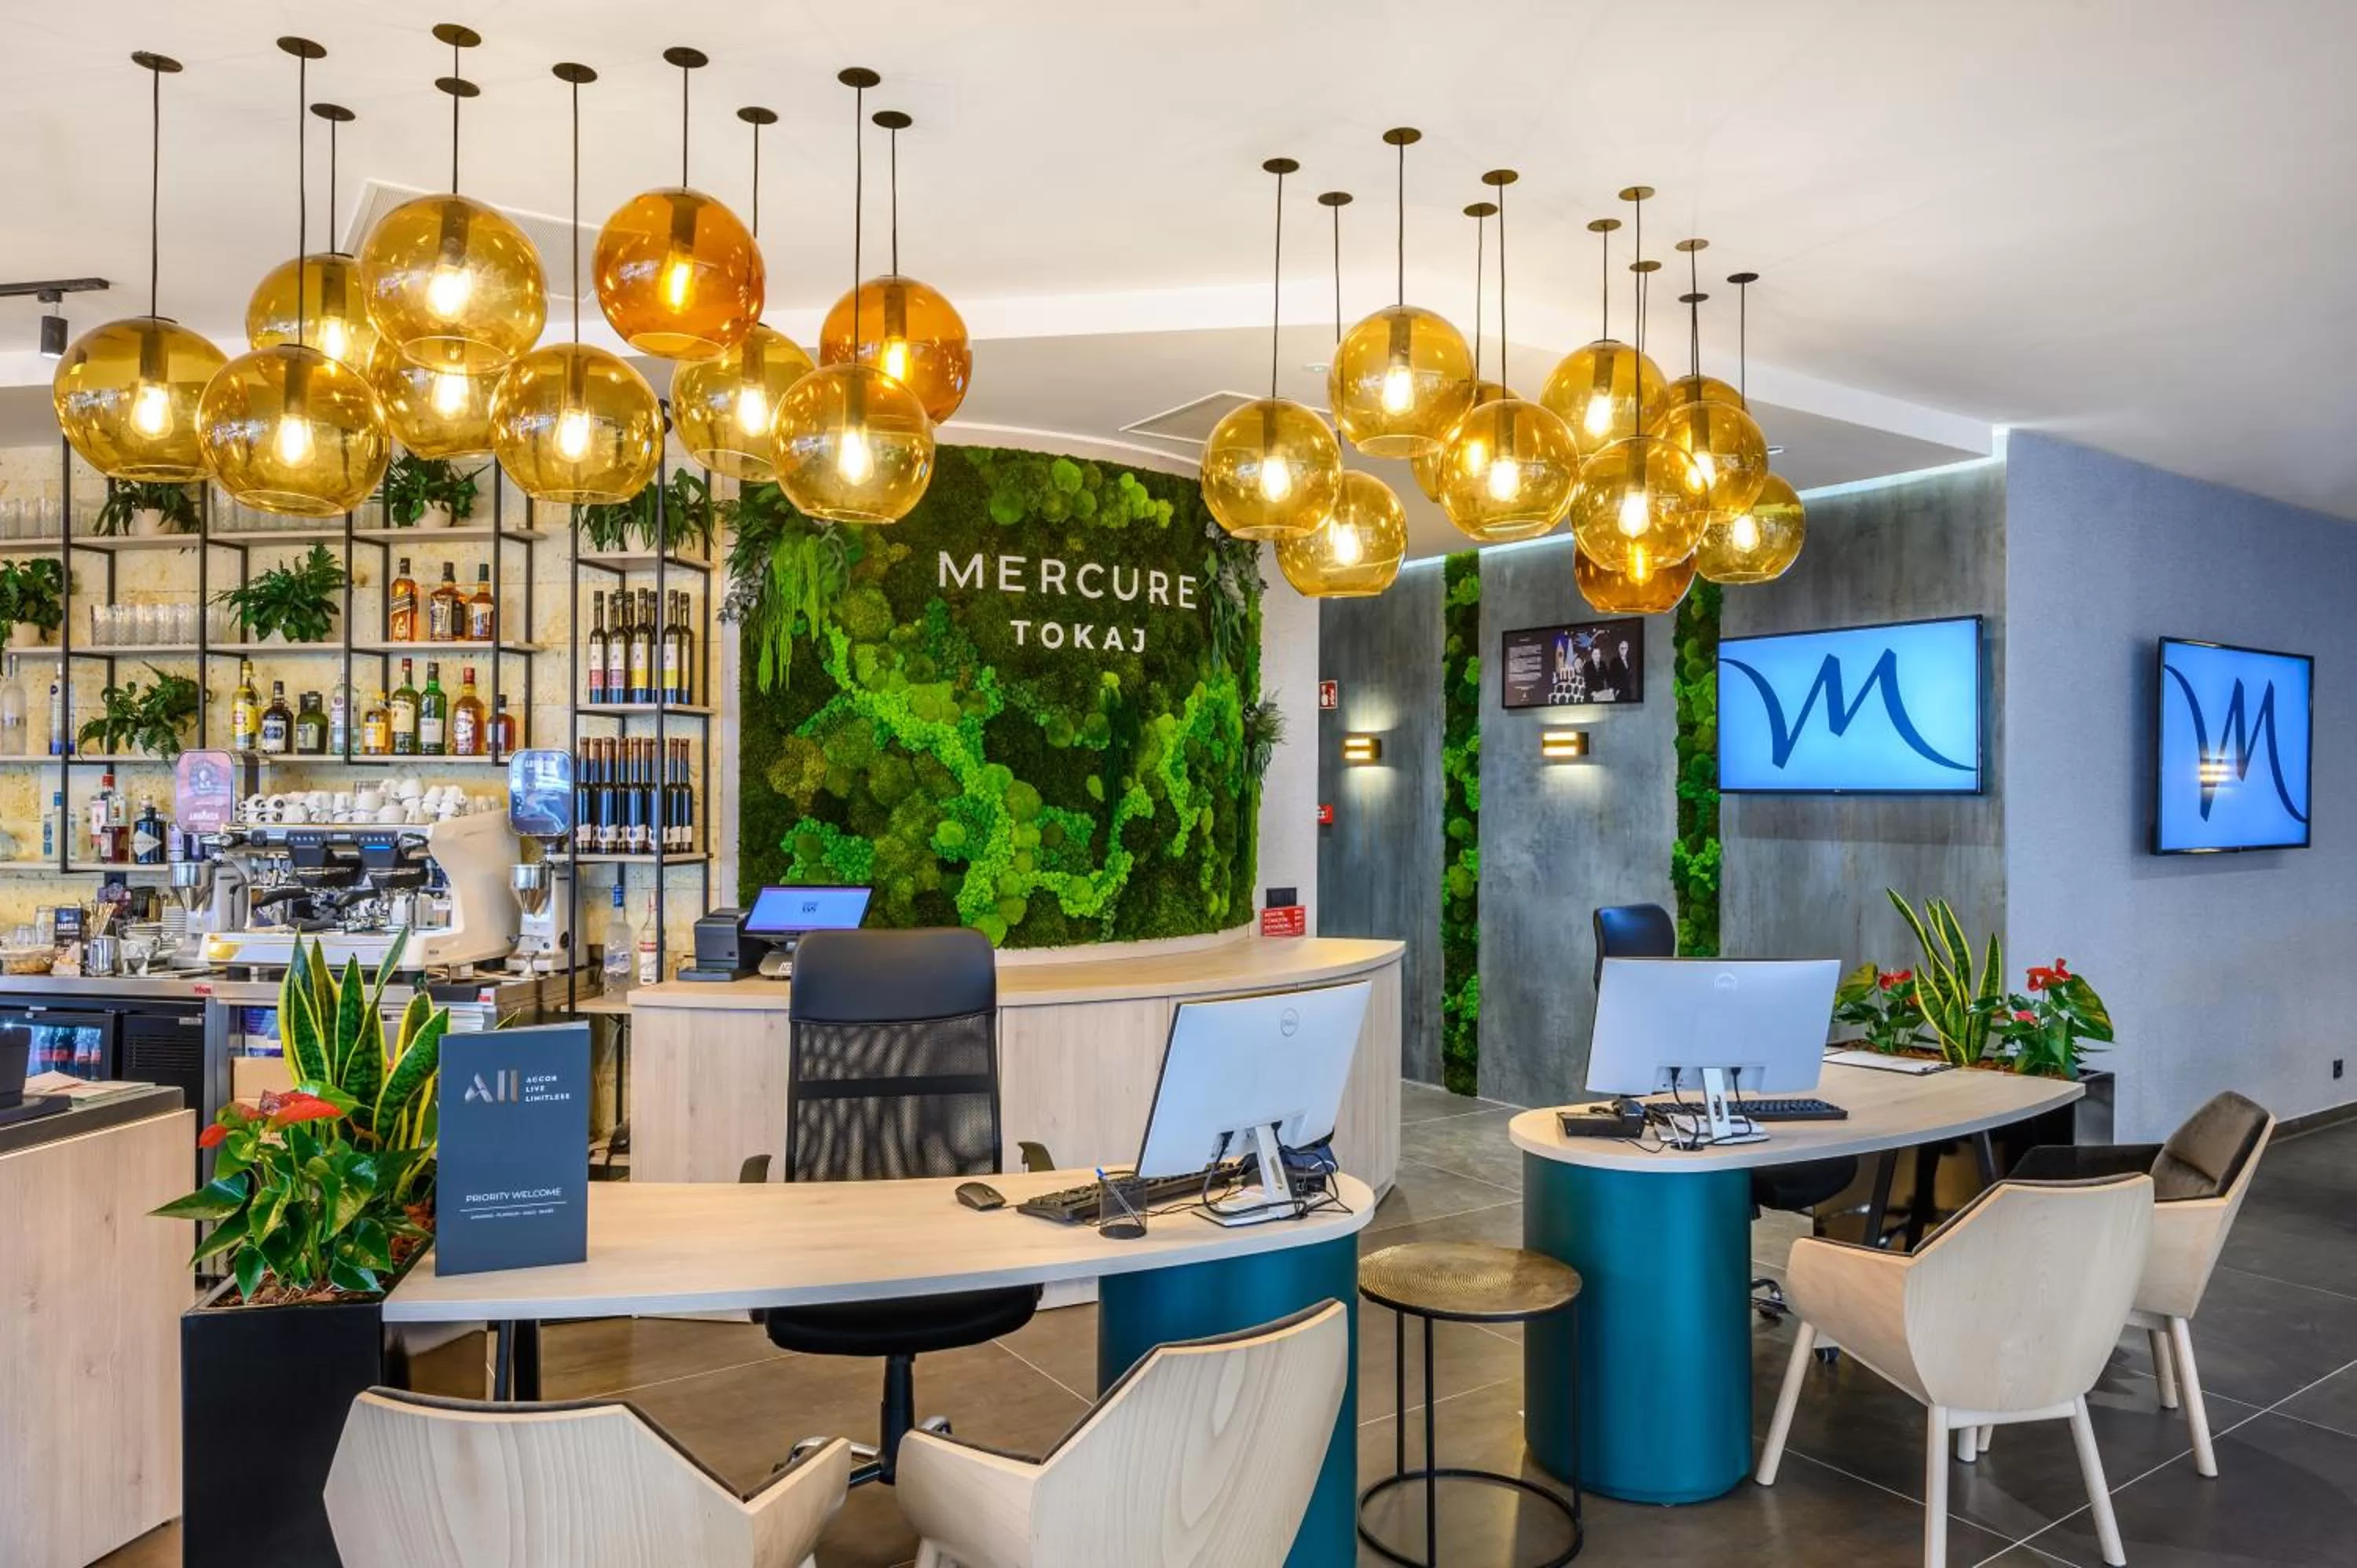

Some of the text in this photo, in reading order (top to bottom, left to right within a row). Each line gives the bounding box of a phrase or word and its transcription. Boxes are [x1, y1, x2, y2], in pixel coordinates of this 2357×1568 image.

[938, 551, 1197, 610] MERCURE
[1010, 621, 1146, 654] TOKAJ
[526, 1093, 570, 1103] LIMITLESS
[465, 1187, 563, 1203] PRIORITY WELCOME
